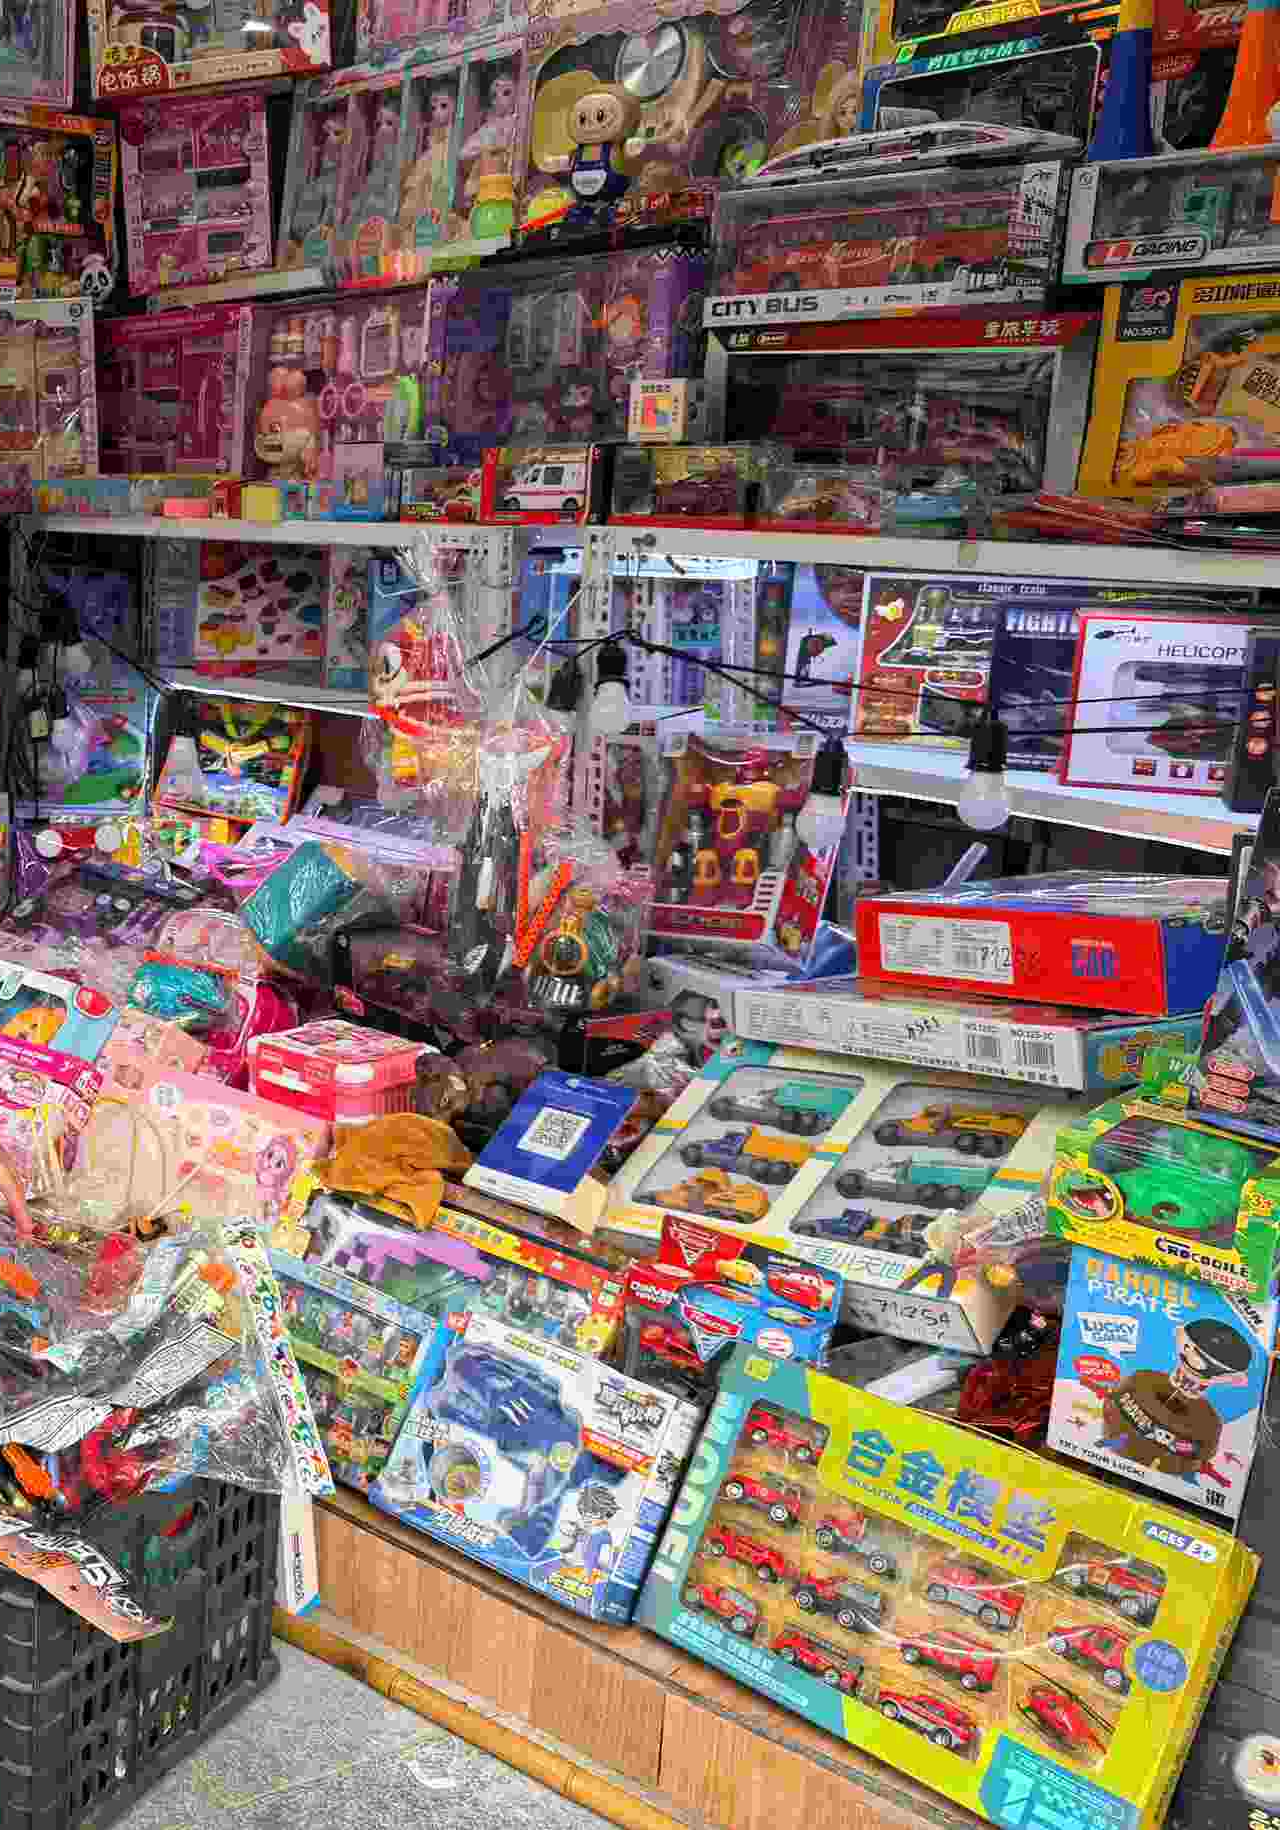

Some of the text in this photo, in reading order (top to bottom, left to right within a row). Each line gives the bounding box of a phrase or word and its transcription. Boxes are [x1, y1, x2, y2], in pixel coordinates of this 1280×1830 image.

[710, 294, 819, 317] CITY BUS
[1149, 1523, 1186, 1548] AGES
